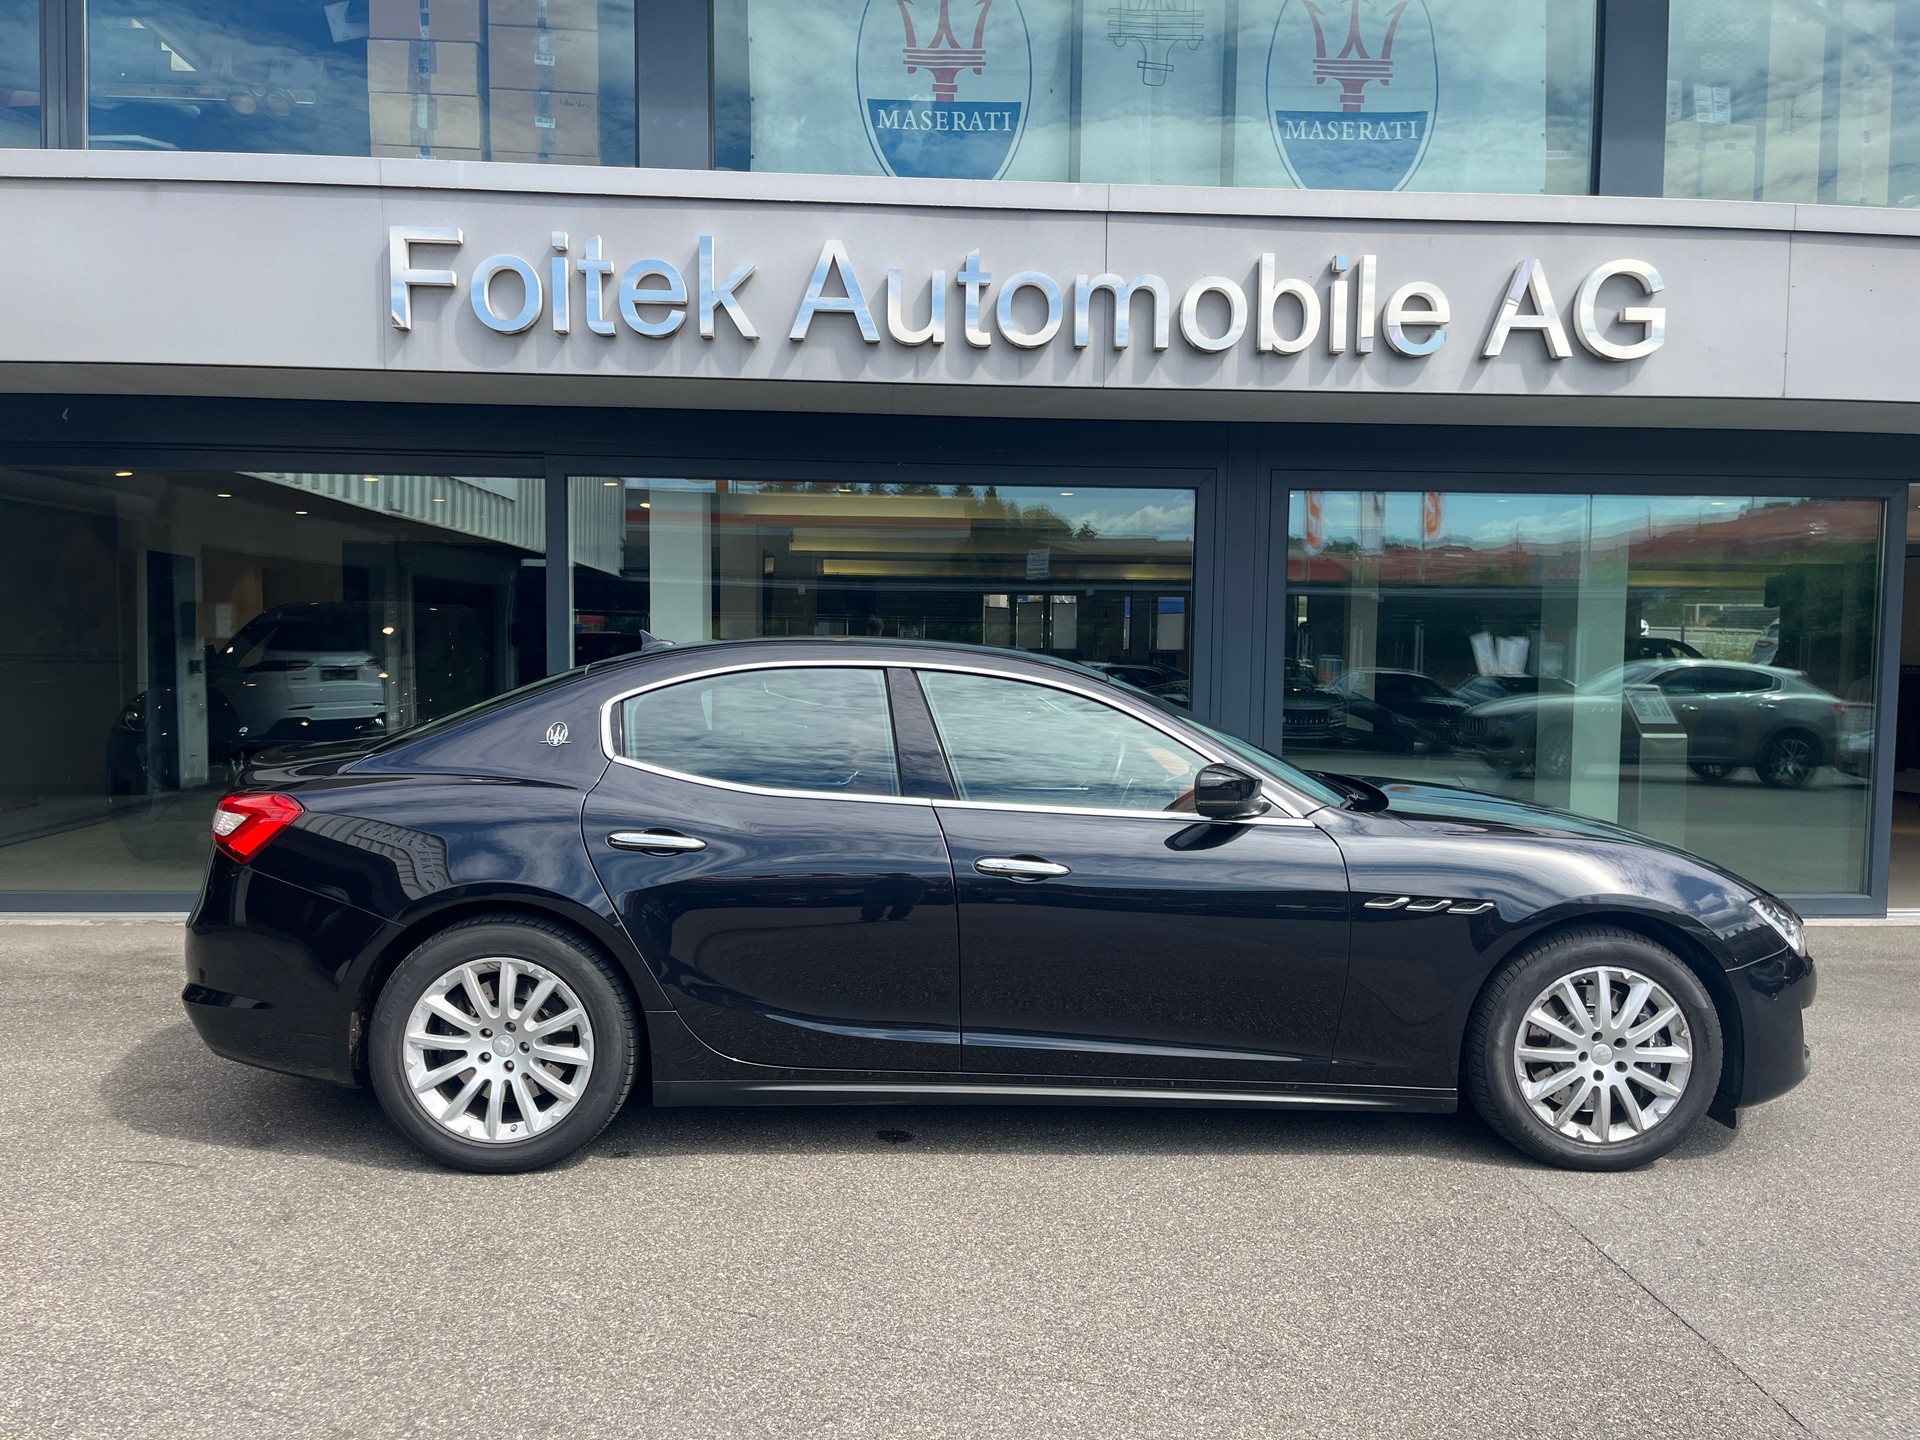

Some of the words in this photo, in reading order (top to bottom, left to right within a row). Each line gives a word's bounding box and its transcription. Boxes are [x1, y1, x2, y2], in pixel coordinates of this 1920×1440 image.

[876, 109, 1012, 132] MASERATI
[1284, 119, 1419, 142] MASERATI
[389, 225, 761, 342] Foitek
[788, 239, 1451, 358] Automobile
[1481, 258, 1667, 362] AG
